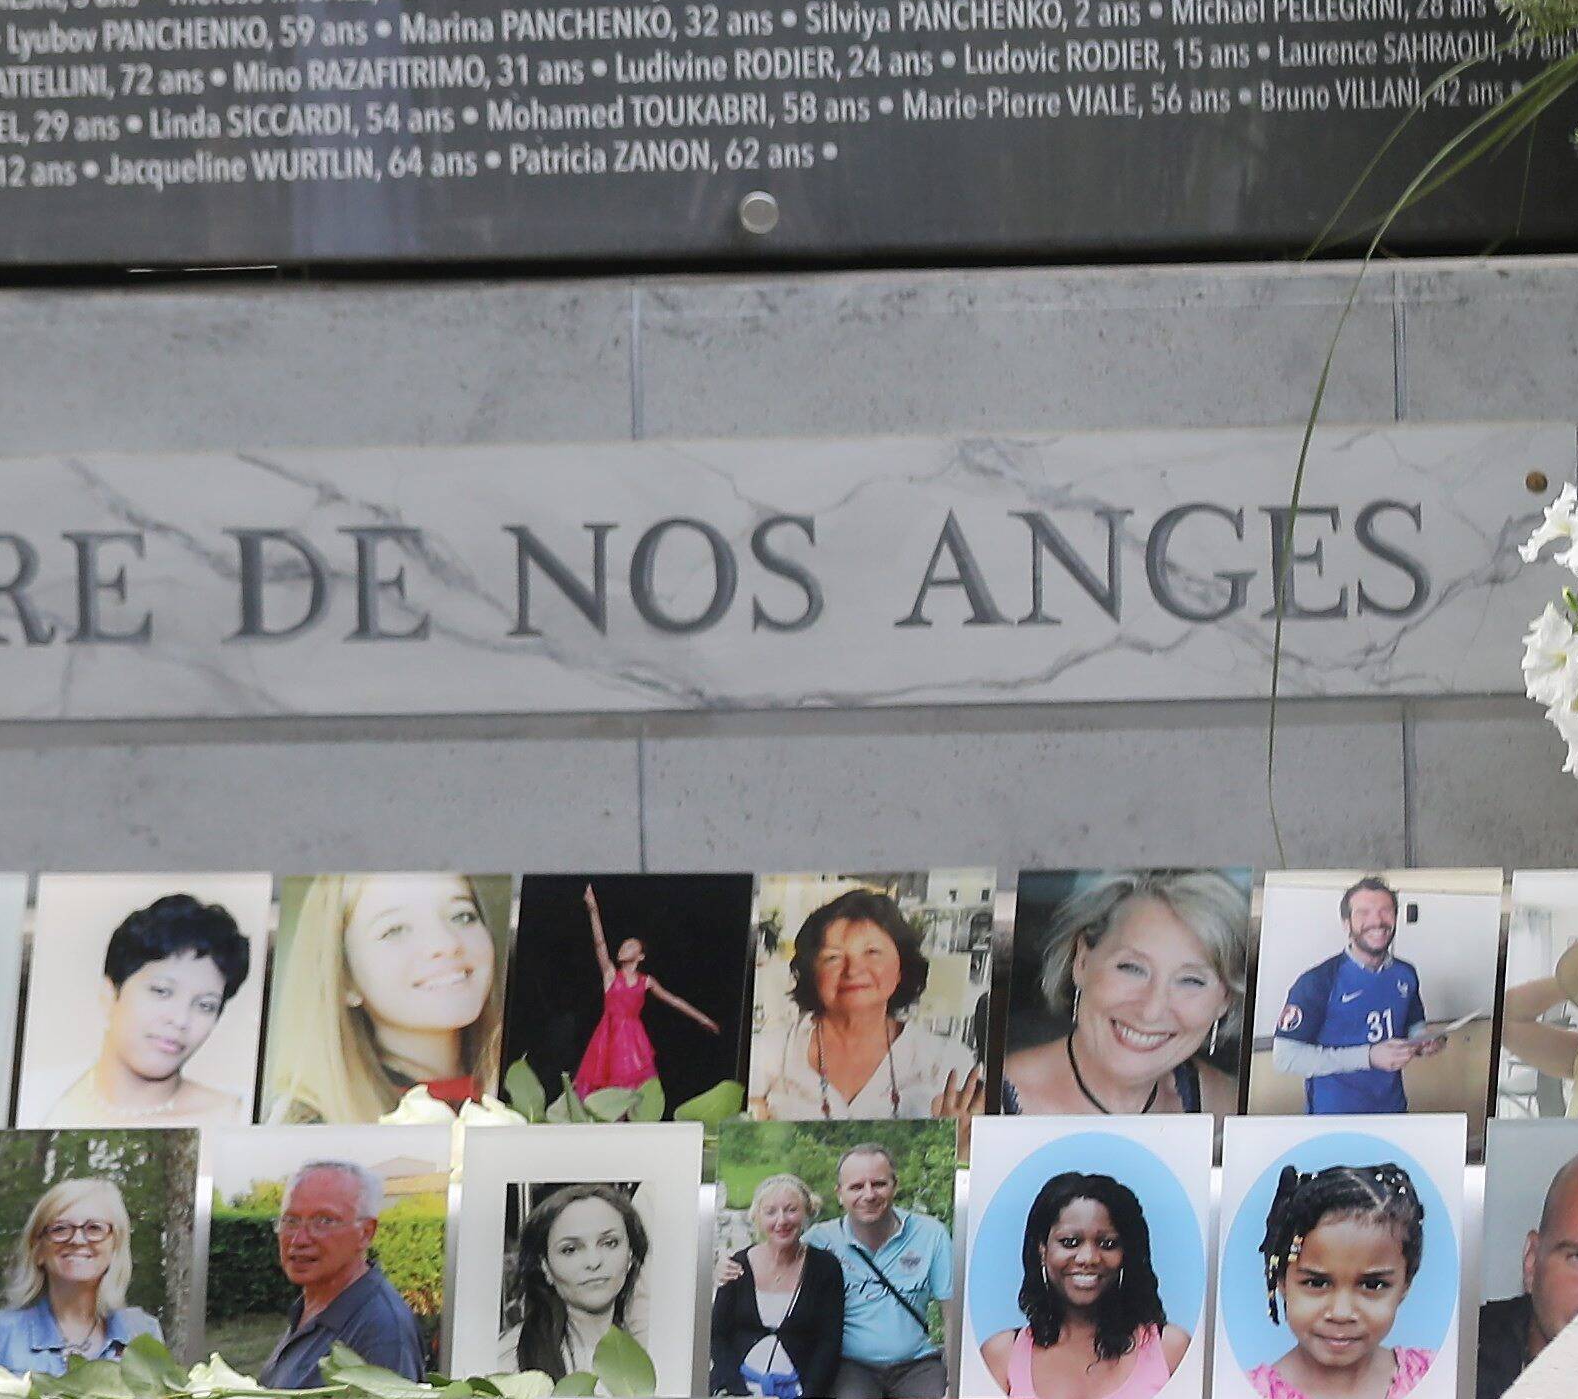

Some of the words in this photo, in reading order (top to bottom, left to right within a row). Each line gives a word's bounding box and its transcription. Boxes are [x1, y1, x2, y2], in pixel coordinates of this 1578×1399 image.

[279, 14, 316, 48] 59
[319, 20, 368, 47] ans
[398, 10, 494, 45] Marina
[500, 6, 677, 42] PANCHENKO,
[684, 5, 719, 38] 32
[726, 11, 774, 36] ans
[804, 0, 891, 41] Silviya
[1097, 2, 1141, 27] ans
[157, 69, 204, 96] ans
[232, 60, 302, 94] Mino
[306, 54, 491, 92] RAZAFITRIMO,
[496, 54, 529, 87] 31
[537, 60, 584, 86] ans
[614, 50, 727, 84] Ludivine
[733, 46, 841, 81] RODIER,
[847, 46, 881, 78] 24
[888, 51, 933, 77] ans
[963, 40, 1060, 75] Ludovic
[1065, 38, 1166, 73] RODIER,
[1173, 37, 1203, 69] 15
[1209, 43, 1250, 68] ans
[226, 102, 360, 138] SICCARDI,
[365, 102, 400, 135] 54
[406, 108, 455, 134] ans
[486, 95, 625, 132] Mohamed
[629, 92, 775, 128] TOUKABRI,
[782, 92, 817, 124] 58
[823, 97, 870, 123] ans
[902, 85, 1061, 121] Marie-Pierre
[1066, 83, 1143, 117] VIALE,
[1150, 82, 1182, 114] 56
[1189, 88, 1230, 113] ans
[250, 146, 382, 182] WURTLIN,
[387, 146, 423, 179] 64
[430, 151, 478, 177] ans
[509, 141, 607, 175] Patricia
[612, 138, 718, 173] ZANON,
[724, 138, 760, 170] 62
[767, 143, 814, 169] ans
[221, 526, 431, 643] DE
[501, 514, 825, 637] NOS
[892, 499, 1432, 627] ANGES
[1365, 1007, 1393, 1043] 31
